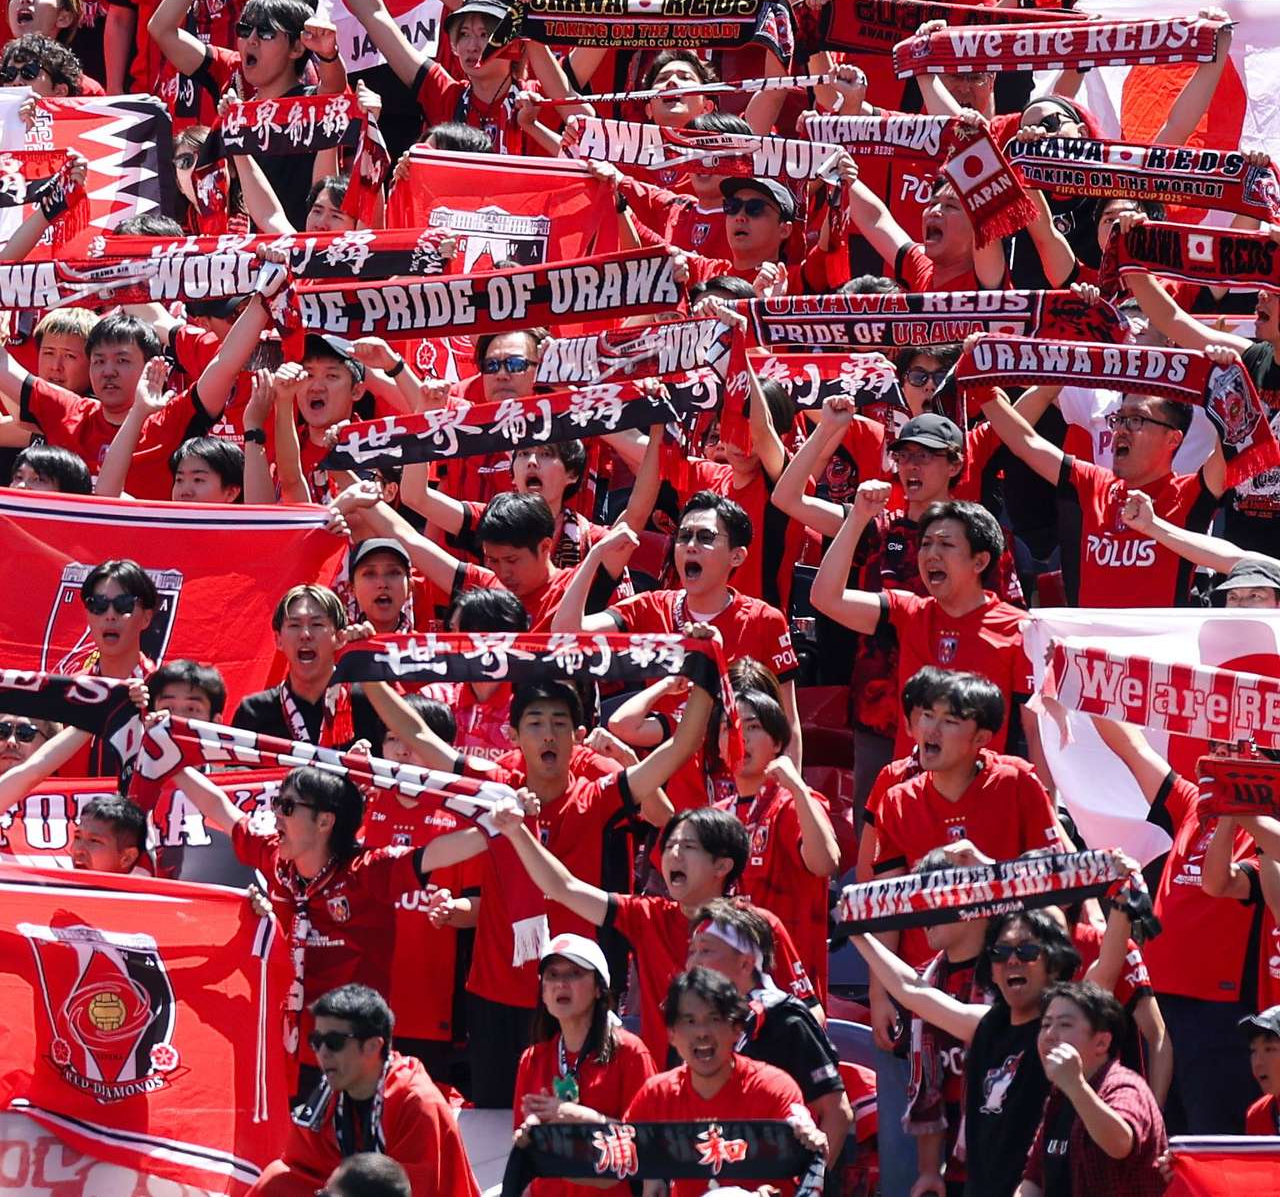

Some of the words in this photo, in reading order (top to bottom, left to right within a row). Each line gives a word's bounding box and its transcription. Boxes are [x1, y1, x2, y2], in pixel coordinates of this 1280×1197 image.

[952, 32, 1001, 57] We
[1008, 28, 1073, 54] are
[1086, 19, 1200, 51] REDS!
[221, 97, 352, 151] 世界制覇
[807, 118, 880, 143] URAWA
[885, 117, 941, 155] REDS
[1009, 140, 1102, 167] URAWA
[1146, 147, 1242, 174] REDS
[967, 174, 1014, 213] JAPAN
[1025, 167, 1085, 187] TAKING
[1091, 173, 1113, 188] ON
[1117, 175, 1146, 192] THE
[1149, 182, 1224, 199] WORLD!
[361, 285, 477, 330] PRIDE
[488, 277, 536, 320] OF
[550, 257, 680, 309] URAWA
[765, 295, 908, 314] URAWA
[923, 292, 1028, 311] REDS
[974, 338, 1092, 371] URAWA
[1108, 346, 1187, 382] REDS
[336, 385, 629, 462] 世界制覇
[1086, 534, 1156, 566] POLUS
[377, 633, 685, 677] 世界制覇
[1078, 654, 1143, 707] We
[1154, 681, 1231, 725] are
